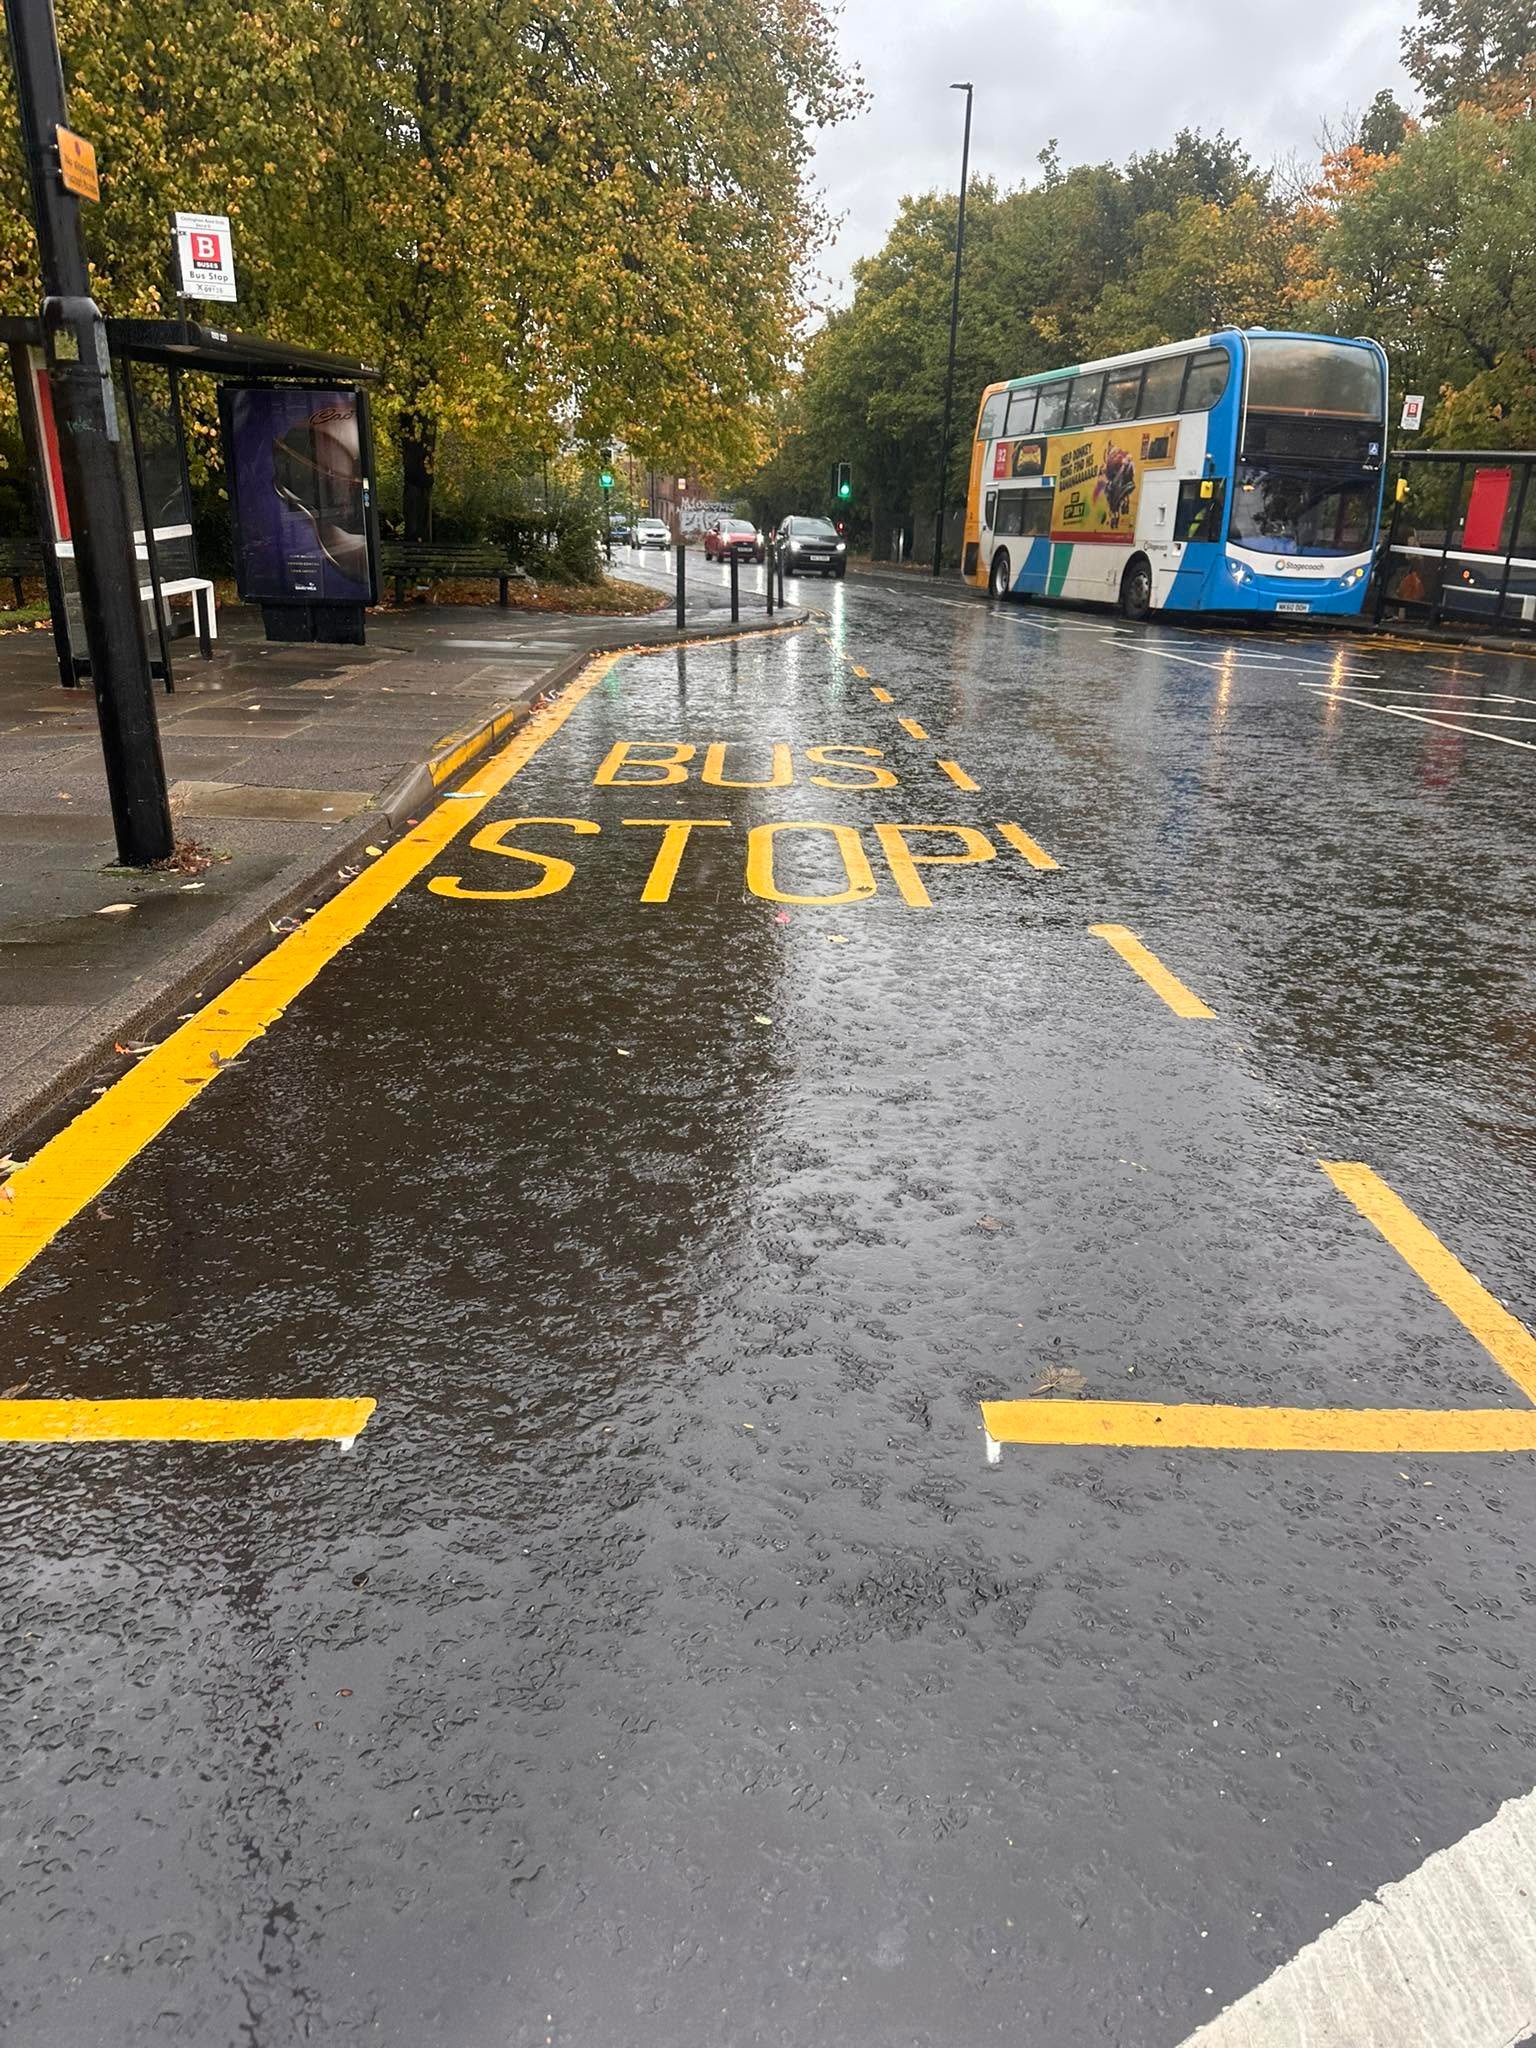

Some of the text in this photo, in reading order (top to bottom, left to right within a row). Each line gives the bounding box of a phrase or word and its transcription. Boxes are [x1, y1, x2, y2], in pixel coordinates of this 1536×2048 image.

[196, 236, 215, 258] B
[196, 261, 219, 269] BUSES
[189, 271, 229, 282] Bus Stop
[1061, 442, 1093, 466] HELP DONKEY
[1073, 458, 1085, 473] FIND
[1286, 561, 1324, 570] Stagecoach
[594, 741, 898, 789] BUS
[427, 817, 996, 907] STOP
